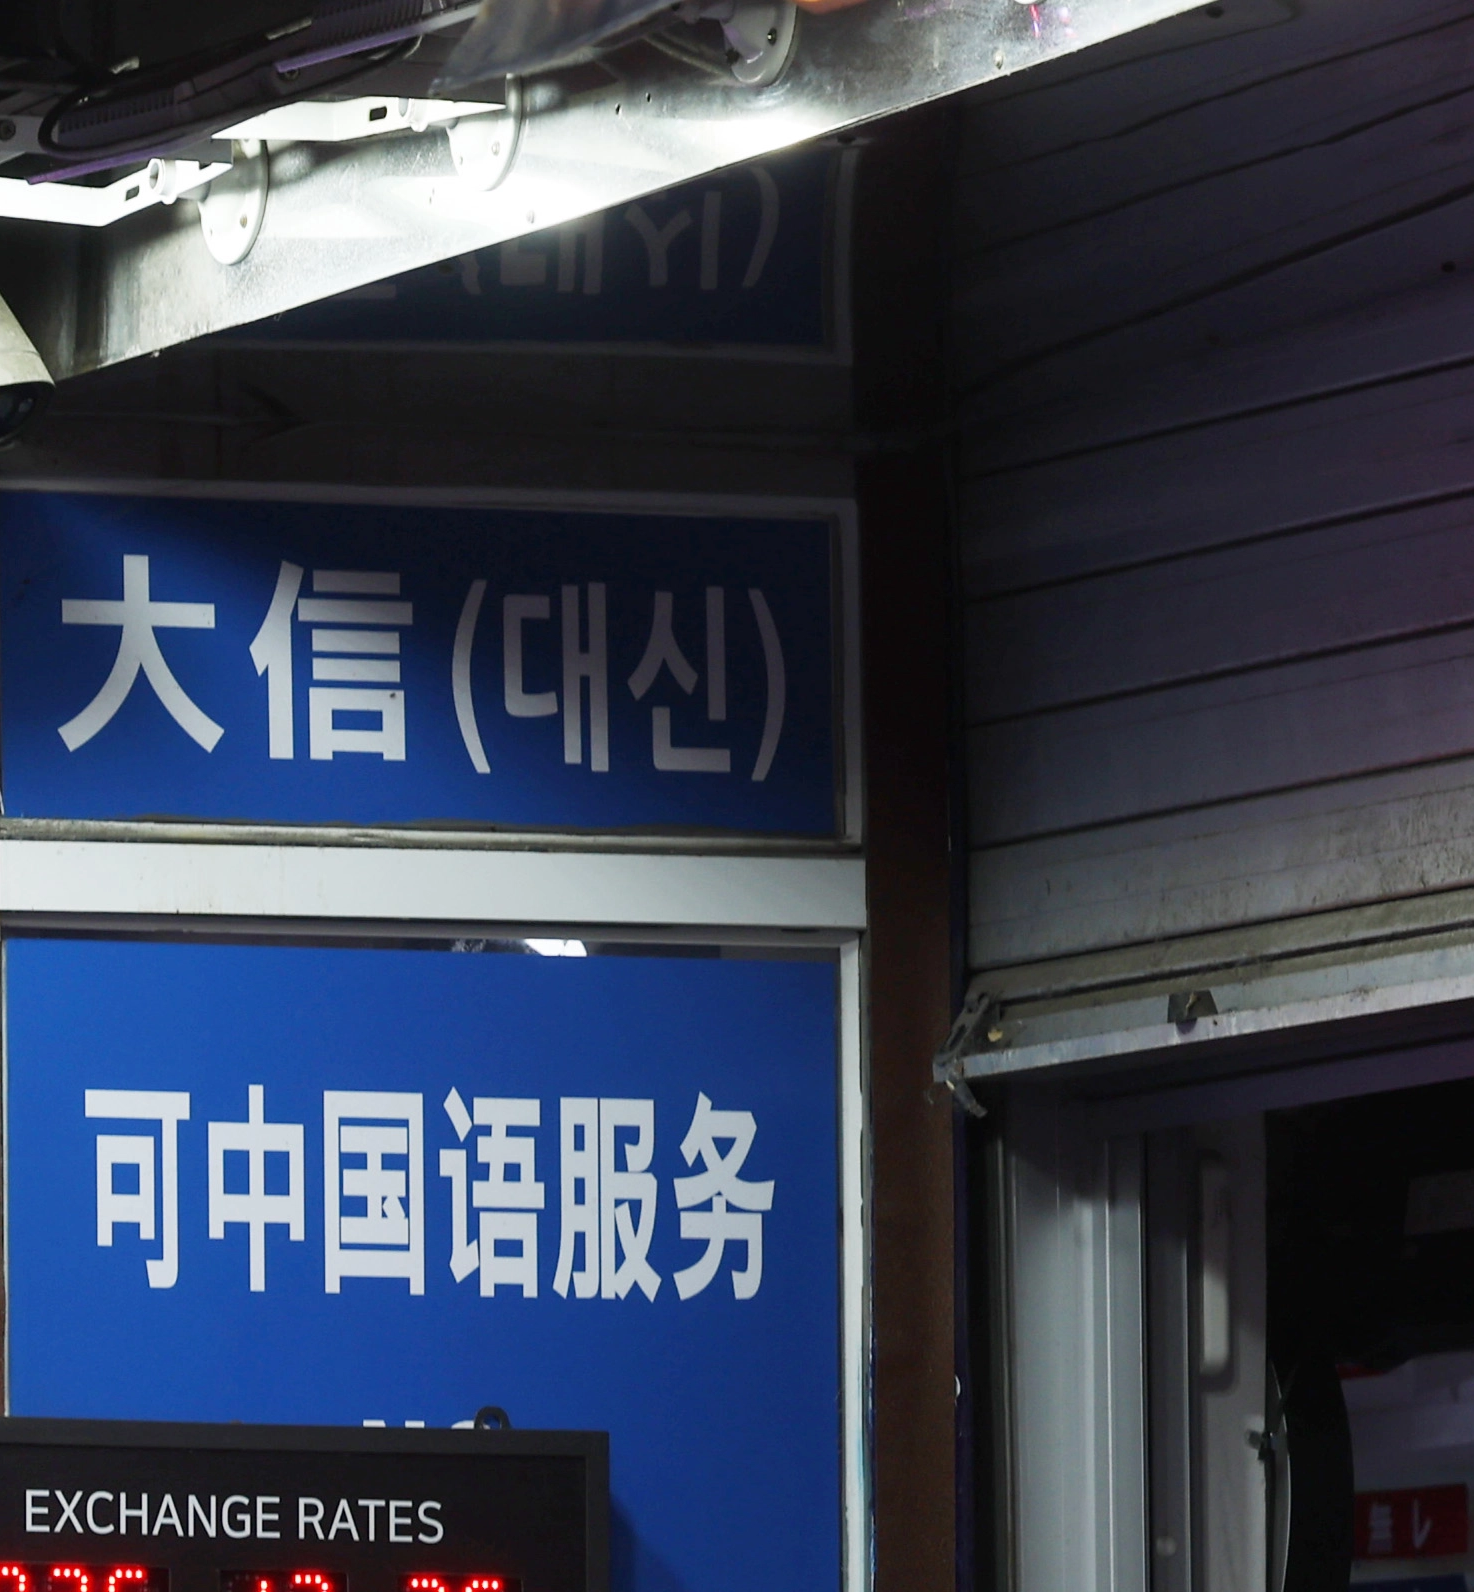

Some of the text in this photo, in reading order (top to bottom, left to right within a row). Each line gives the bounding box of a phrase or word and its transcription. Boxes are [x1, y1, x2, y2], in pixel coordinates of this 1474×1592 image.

[57, 554, 788, 783] 大信 (대신)
[84, 1084, 775, 1303] 可中国语服务
[25, 1489, 444, 1544] EXCHANGE RATES
